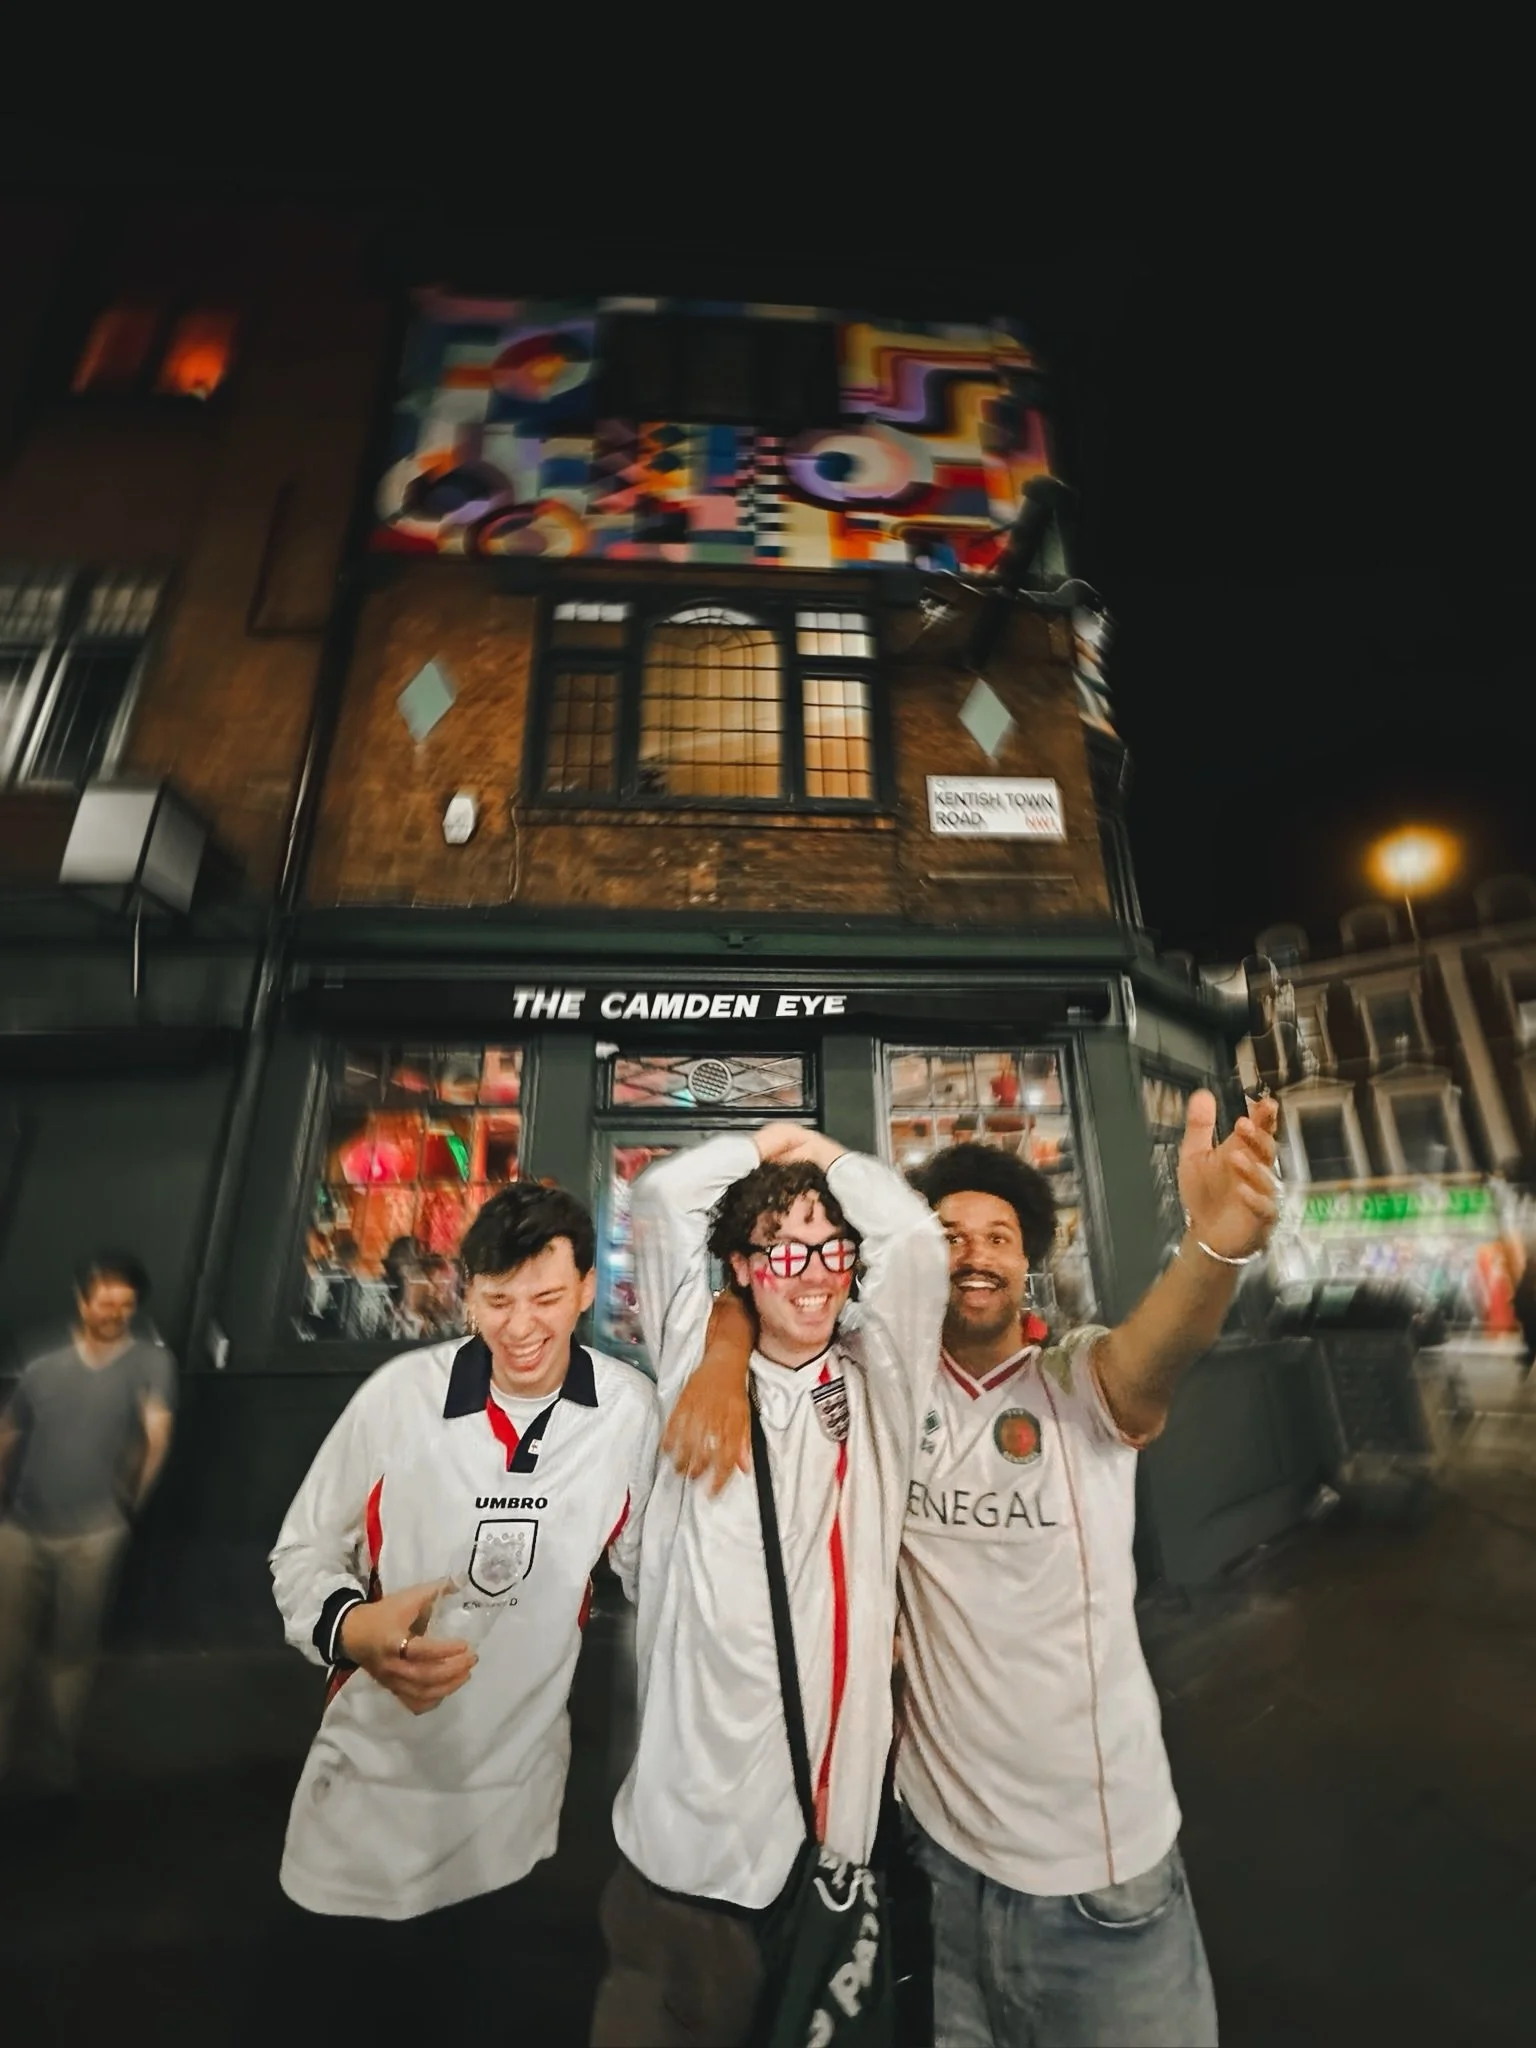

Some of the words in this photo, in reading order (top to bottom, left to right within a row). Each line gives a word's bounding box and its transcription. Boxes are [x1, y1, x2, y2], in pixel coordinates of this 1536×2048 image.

[934, 792, 1000, 807] KENTISH
[1005, 792, 1054, 809] TOWN
[936, 811, 983, 826] ROAD
[513, 986, 586, 1019] THE
[600, 991, 760, 1019] CAMDEN
[775, 995, 847, 1017] EYE
[475, 1497, 548, 1509] UMBRO
[905, 1479, 1057, 1528] ENEGAL
